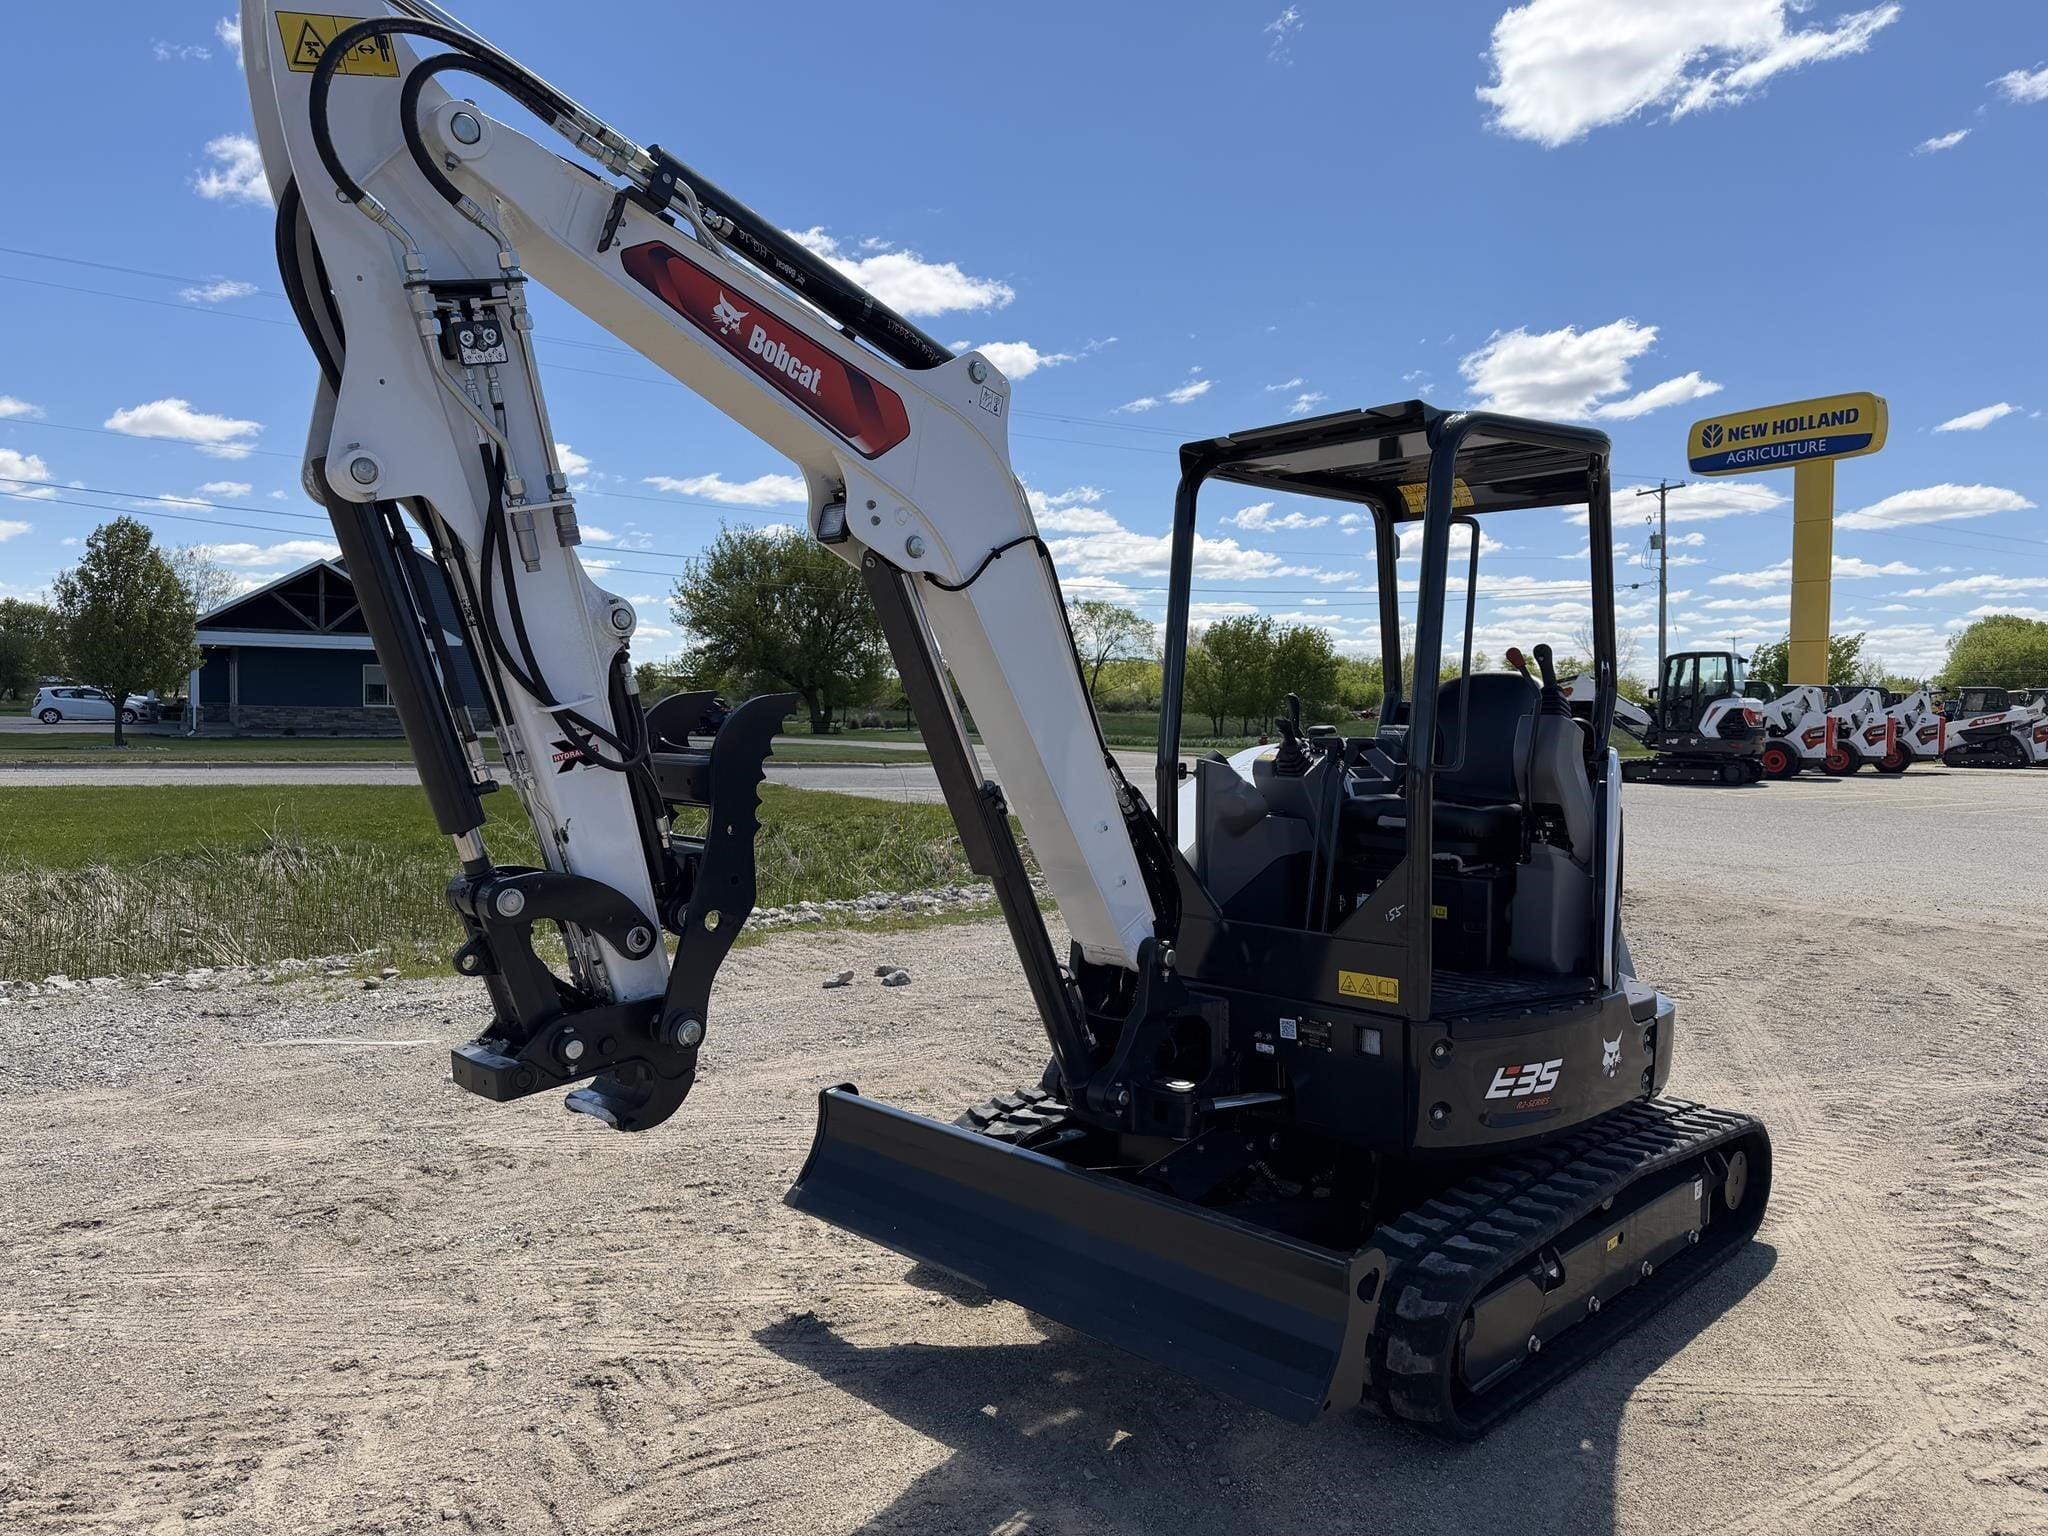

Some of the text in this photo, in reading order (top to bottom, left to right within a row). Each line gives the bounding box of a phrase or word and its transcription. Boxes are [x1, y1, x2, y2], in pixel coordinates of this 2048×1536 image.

[748, 324, 822, 394] Bobcat
[1728, 408, 1859, 442] NEW HOLLAND
[1726, 440, 1827, 464] AGRICULTURE
[1485, 1058, 1563, 1099] E35
